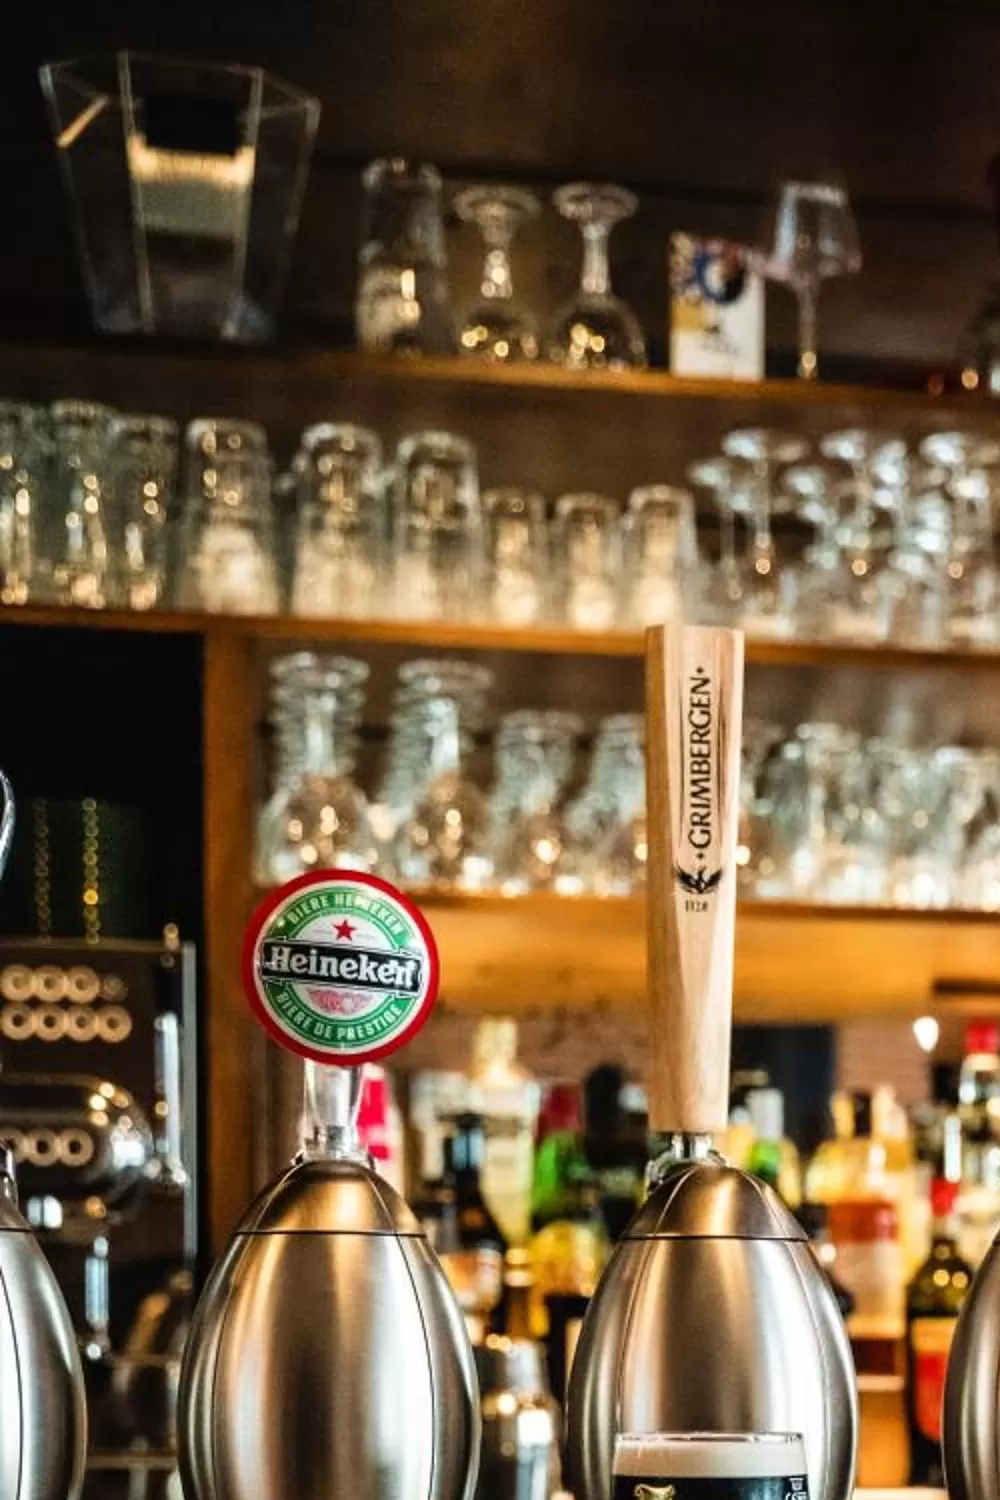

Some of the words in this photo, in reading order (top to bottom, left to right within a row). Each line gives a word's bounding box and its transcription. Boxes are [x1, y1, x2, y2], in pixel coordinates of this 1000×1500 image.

[687, 676, 712, 849] GRIMBERGEN
[270, 945, 414, 987] Heineken
[314, 1022, 333, 1039] DE
